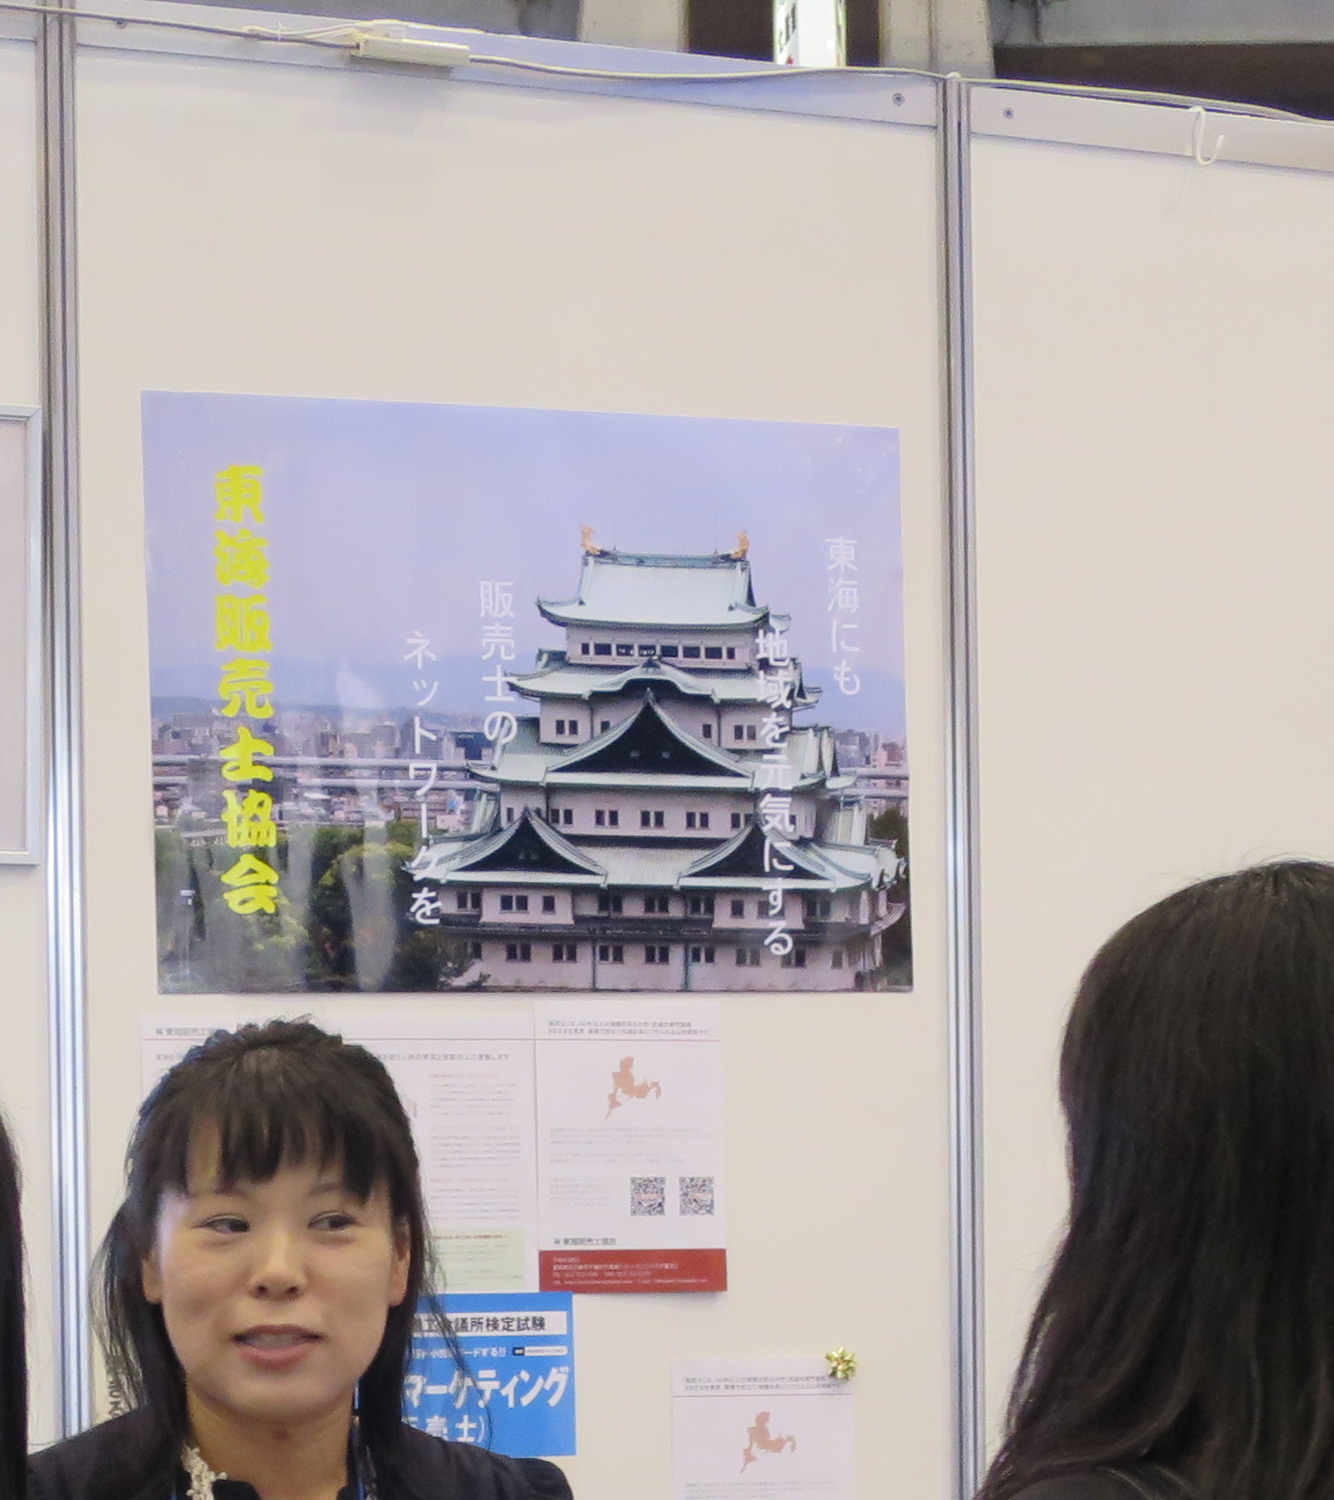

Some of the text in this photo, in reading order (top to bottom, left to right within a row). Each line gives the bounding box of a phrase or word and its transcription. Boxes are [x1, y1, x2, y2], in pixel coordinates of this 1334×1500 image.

[214, 464, 280, 916] 東海販売士協会
[479, 580, 520, 747] 販売士の
[825, 536, 862, 698] 東海にも
[402, 628, 443, 926] ネットワークを
[754, 627, 795, 957] 地域を元気にする
